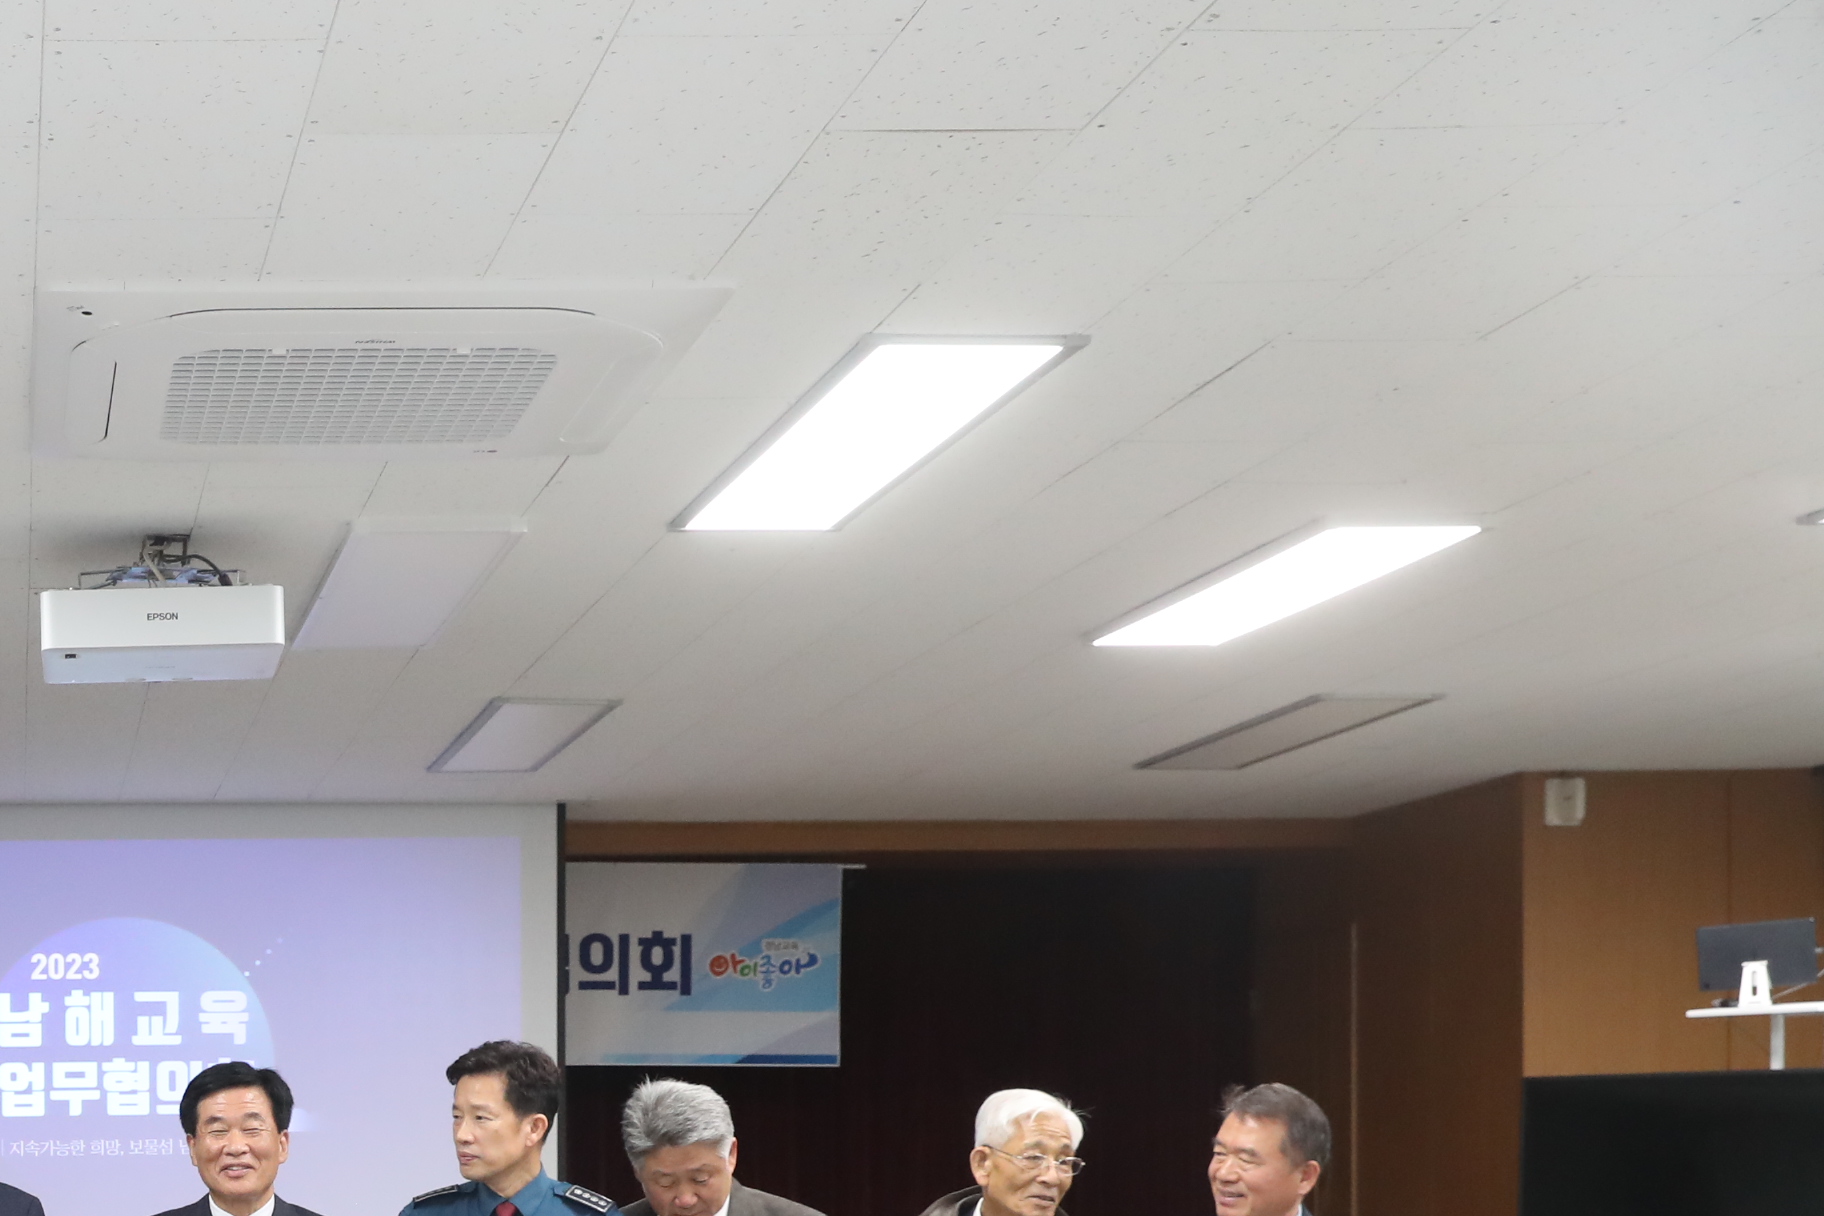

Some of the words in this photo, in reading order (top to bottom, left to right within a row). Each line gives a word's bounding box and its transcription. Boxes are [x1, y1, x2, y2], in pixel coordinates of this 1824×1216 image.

[146, 611, 179, 623] EPSON
[30, 952, 100, 980] 2023
[558, 931, 693, 996] 의회
[708, 951, 819, 990] 아이좋아
[0, 1057, 254, 1117] 업무협의
[10, 1140, 84, 1157] 지속가능한
[91, 1139, 124, 1156] 희망,
[129, 1139, 173, 1155] 보물섬
